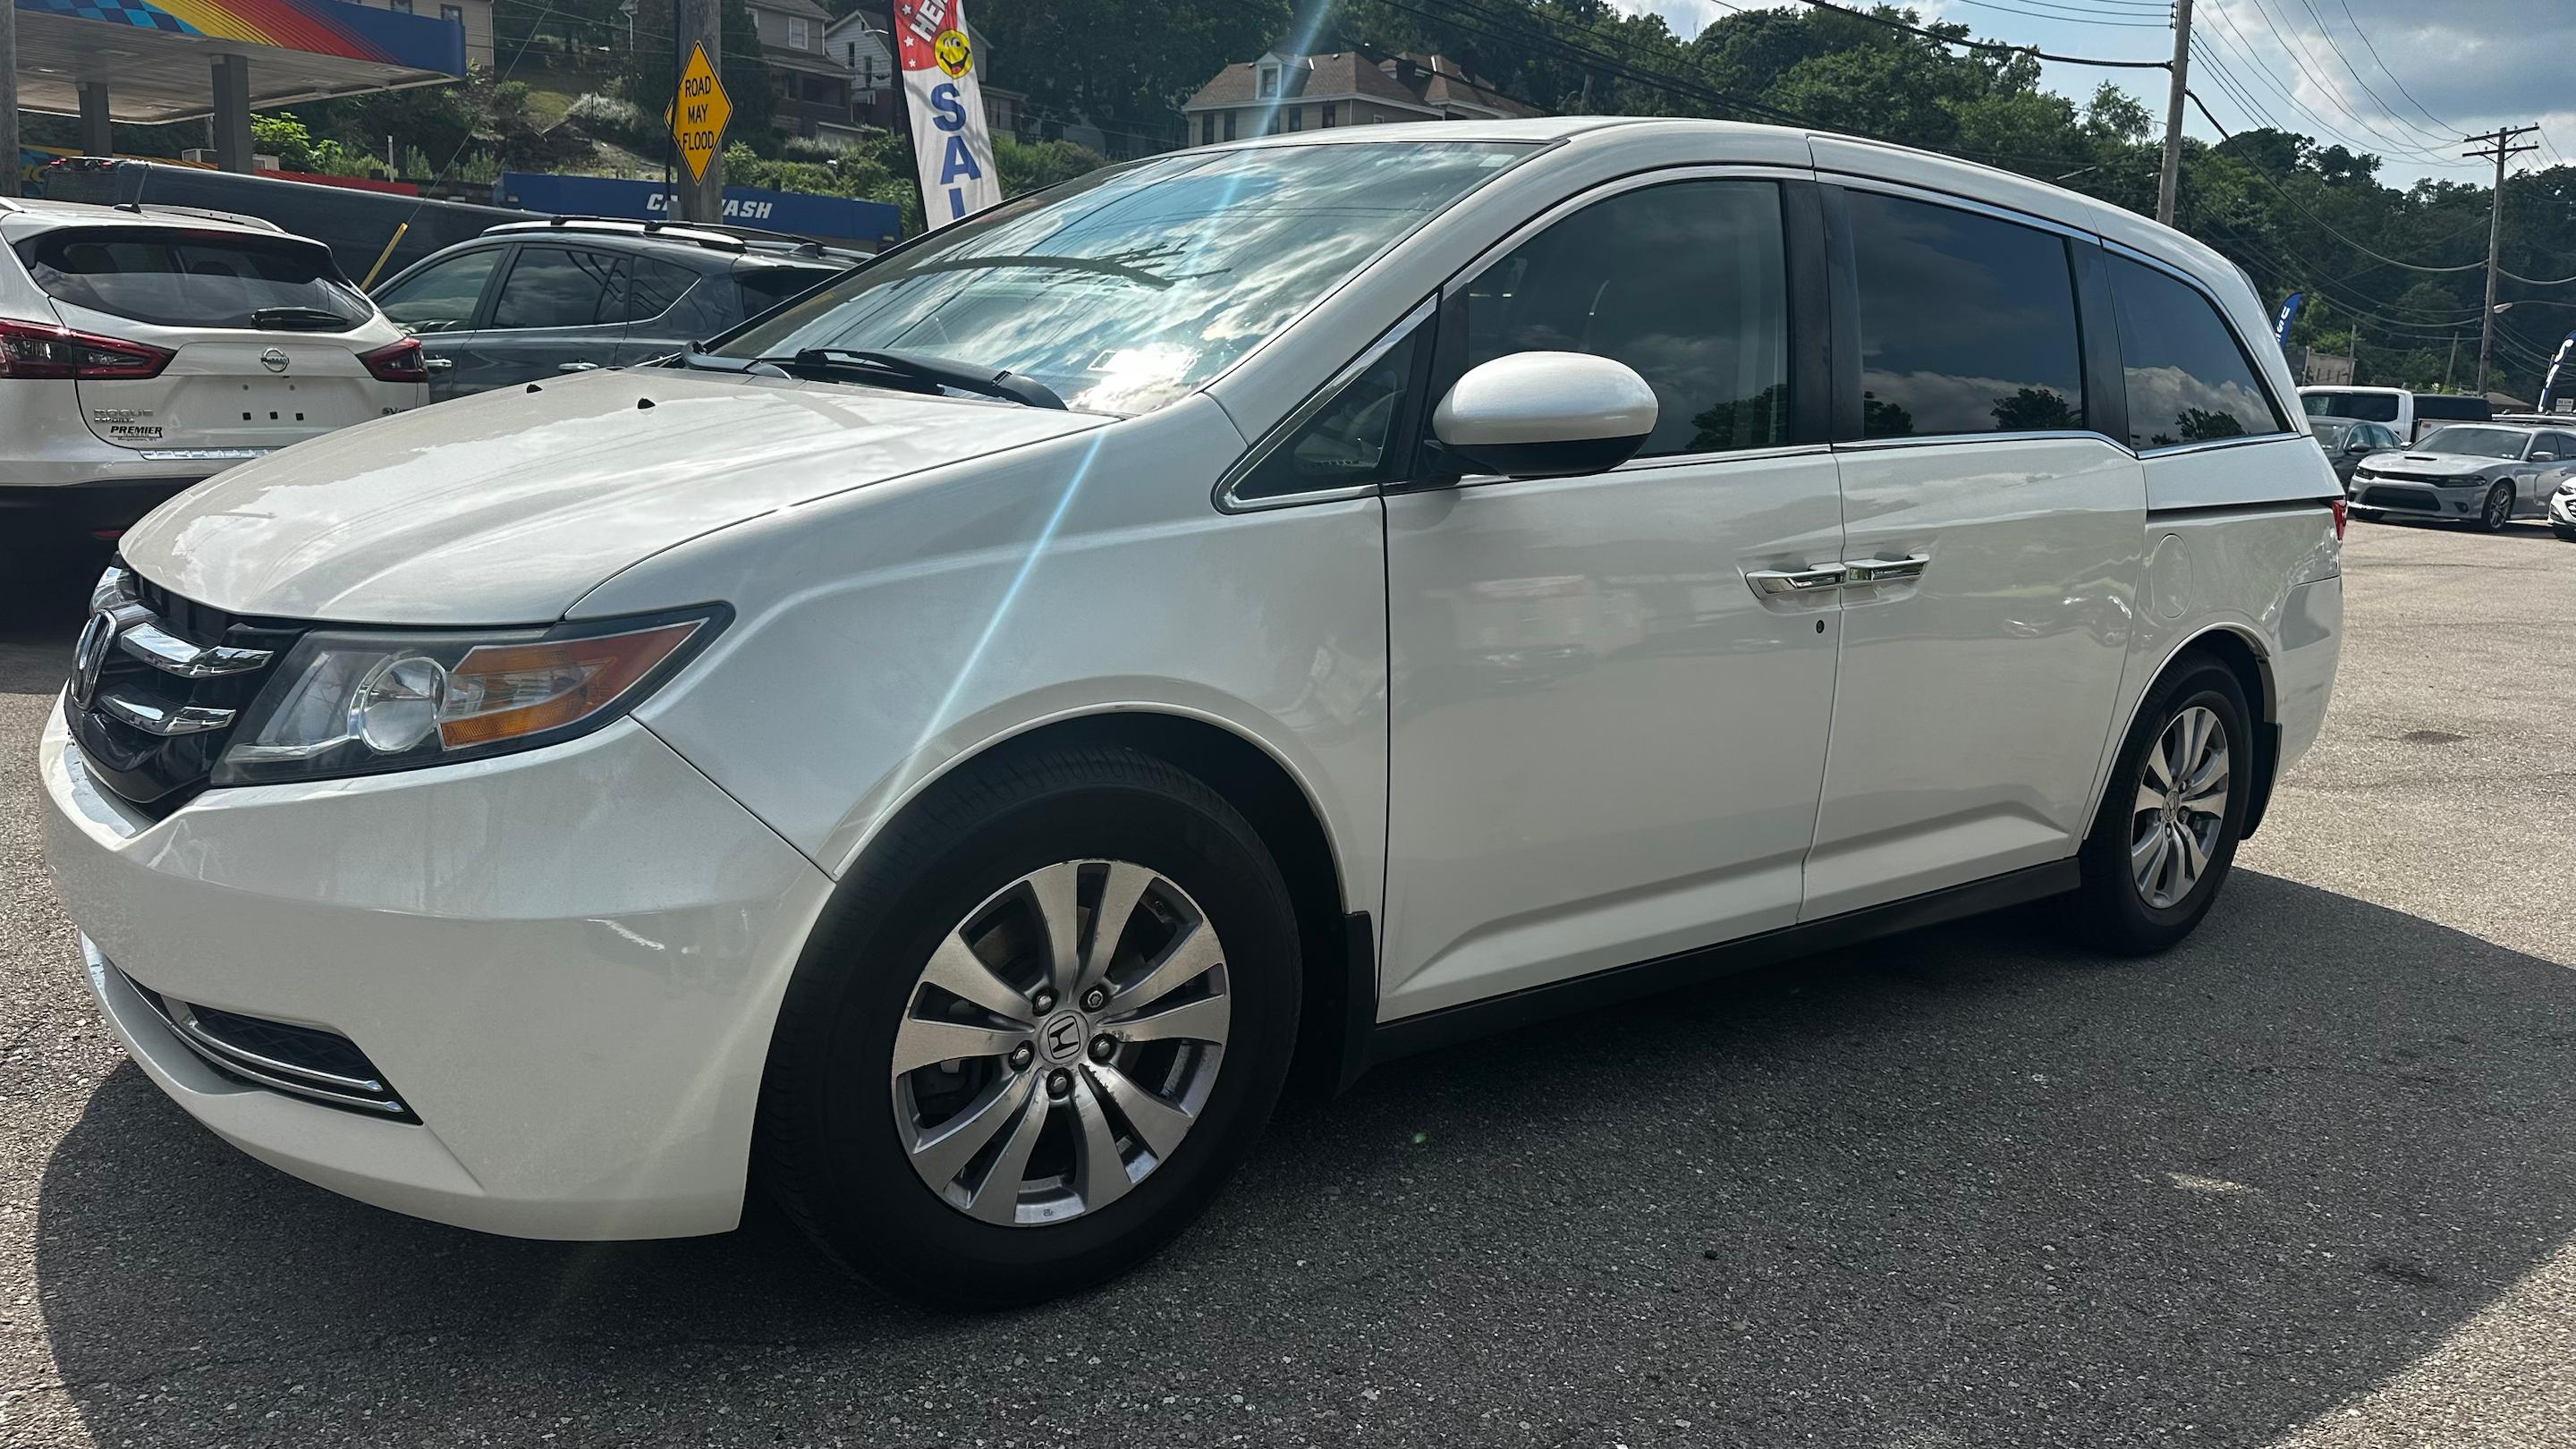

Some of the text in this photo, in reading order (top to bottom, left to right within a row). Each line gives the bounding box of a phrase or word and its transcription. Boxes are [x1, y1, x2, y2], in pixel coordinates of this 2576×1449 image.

[685, 76, 712, 97] ROAD
[687, 104, 708, 124] MAY
[682, 131, 715, 151] FLOOD
[721, 199, 773, 219] ASH
[94, 408, 154, 418] ROGUE
[110, 426, 163, 439] PREMIER
